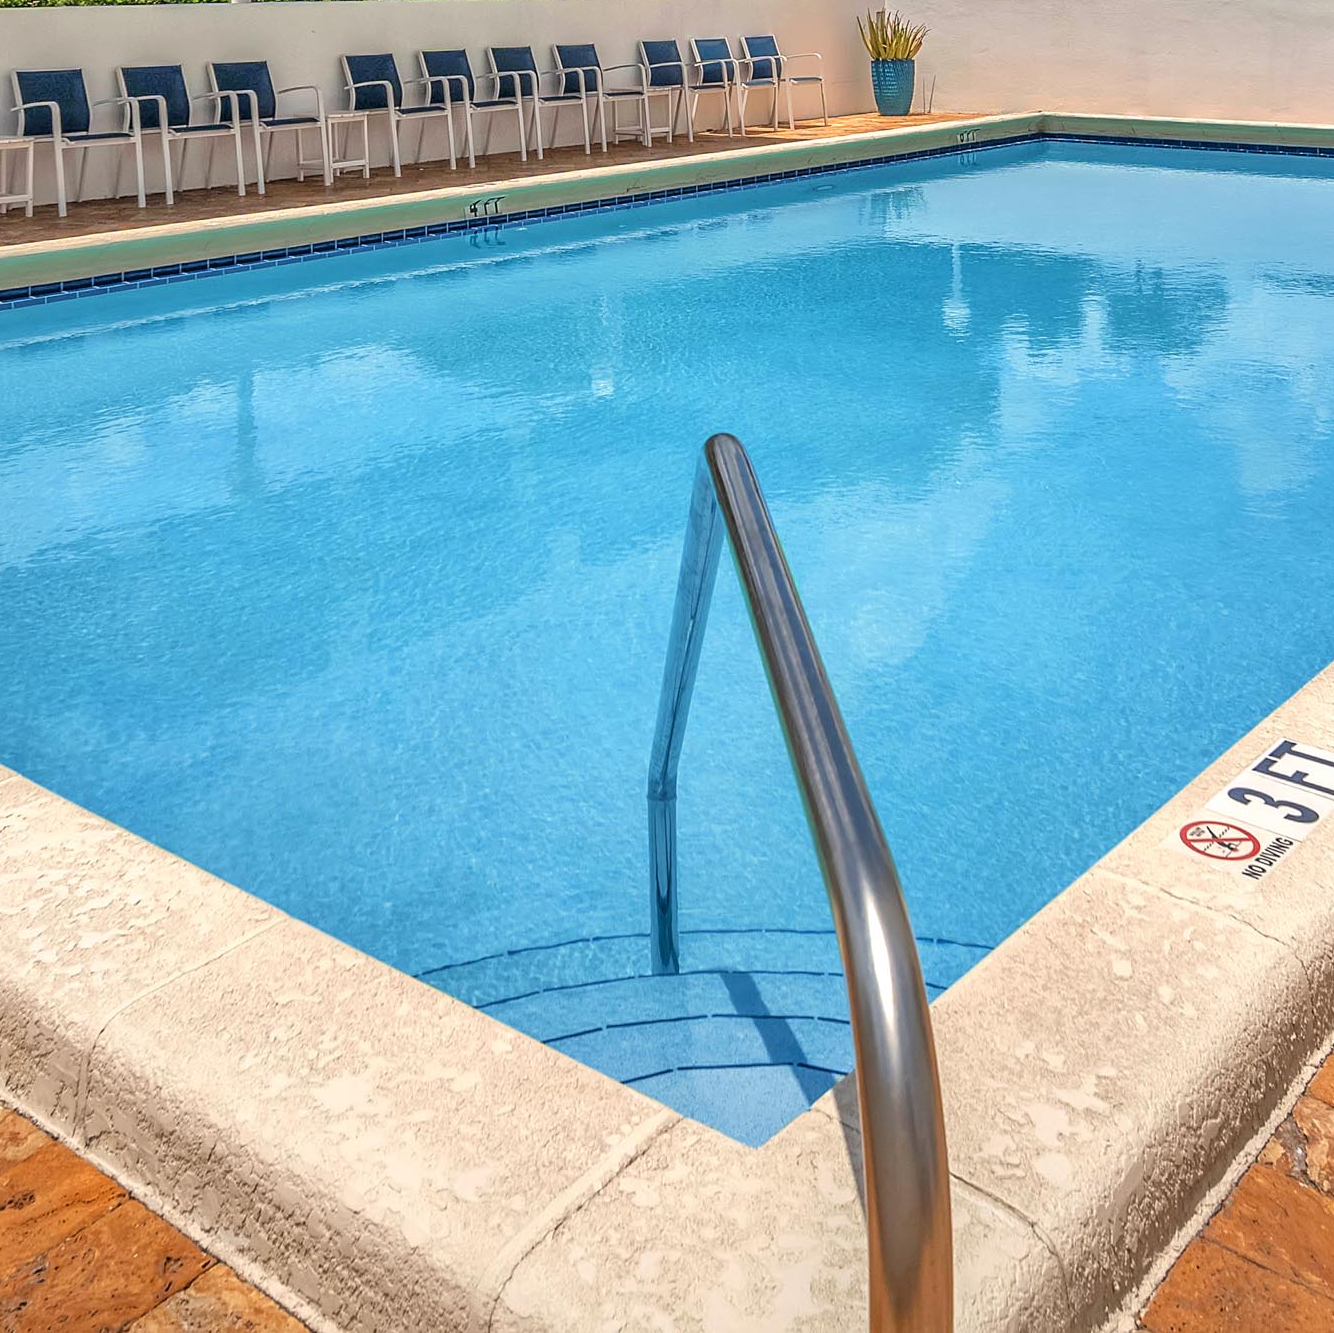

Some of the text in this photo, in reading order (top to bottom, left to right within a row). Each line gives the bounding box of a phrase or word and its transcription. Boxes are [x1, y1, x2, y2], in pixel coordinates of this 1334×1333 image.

[1227, 786, 1320, 824] 3
[1242, 837, 1294, 880] NO DIVING
